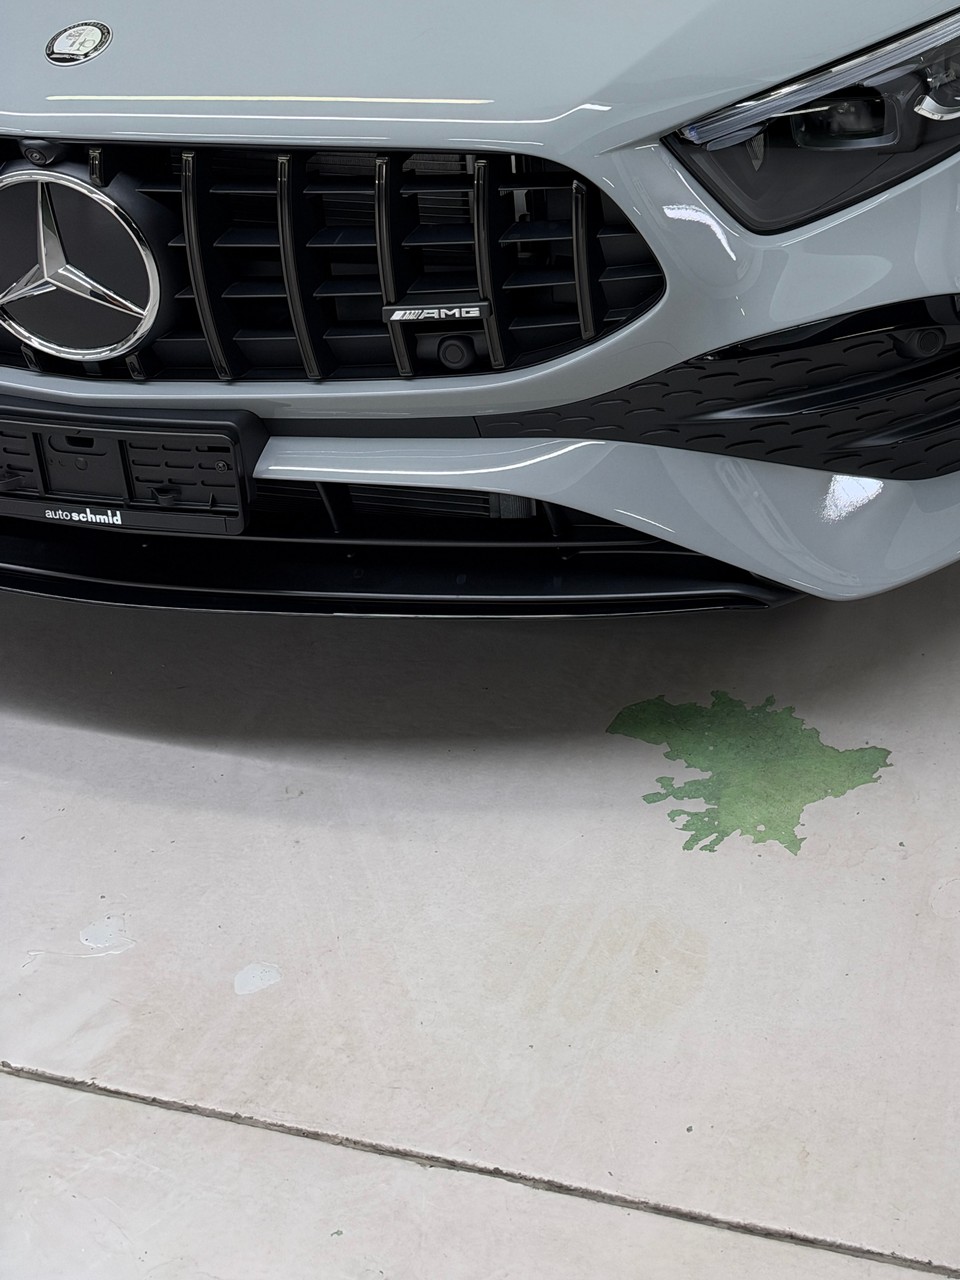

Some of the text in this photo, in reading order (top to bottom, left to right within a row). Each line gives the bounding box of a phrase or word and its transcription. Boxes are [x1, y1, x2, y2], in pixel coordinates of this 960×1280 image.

[418, 307, 480, 319] AMG
[45, 508, 122, 524] auto schmid
